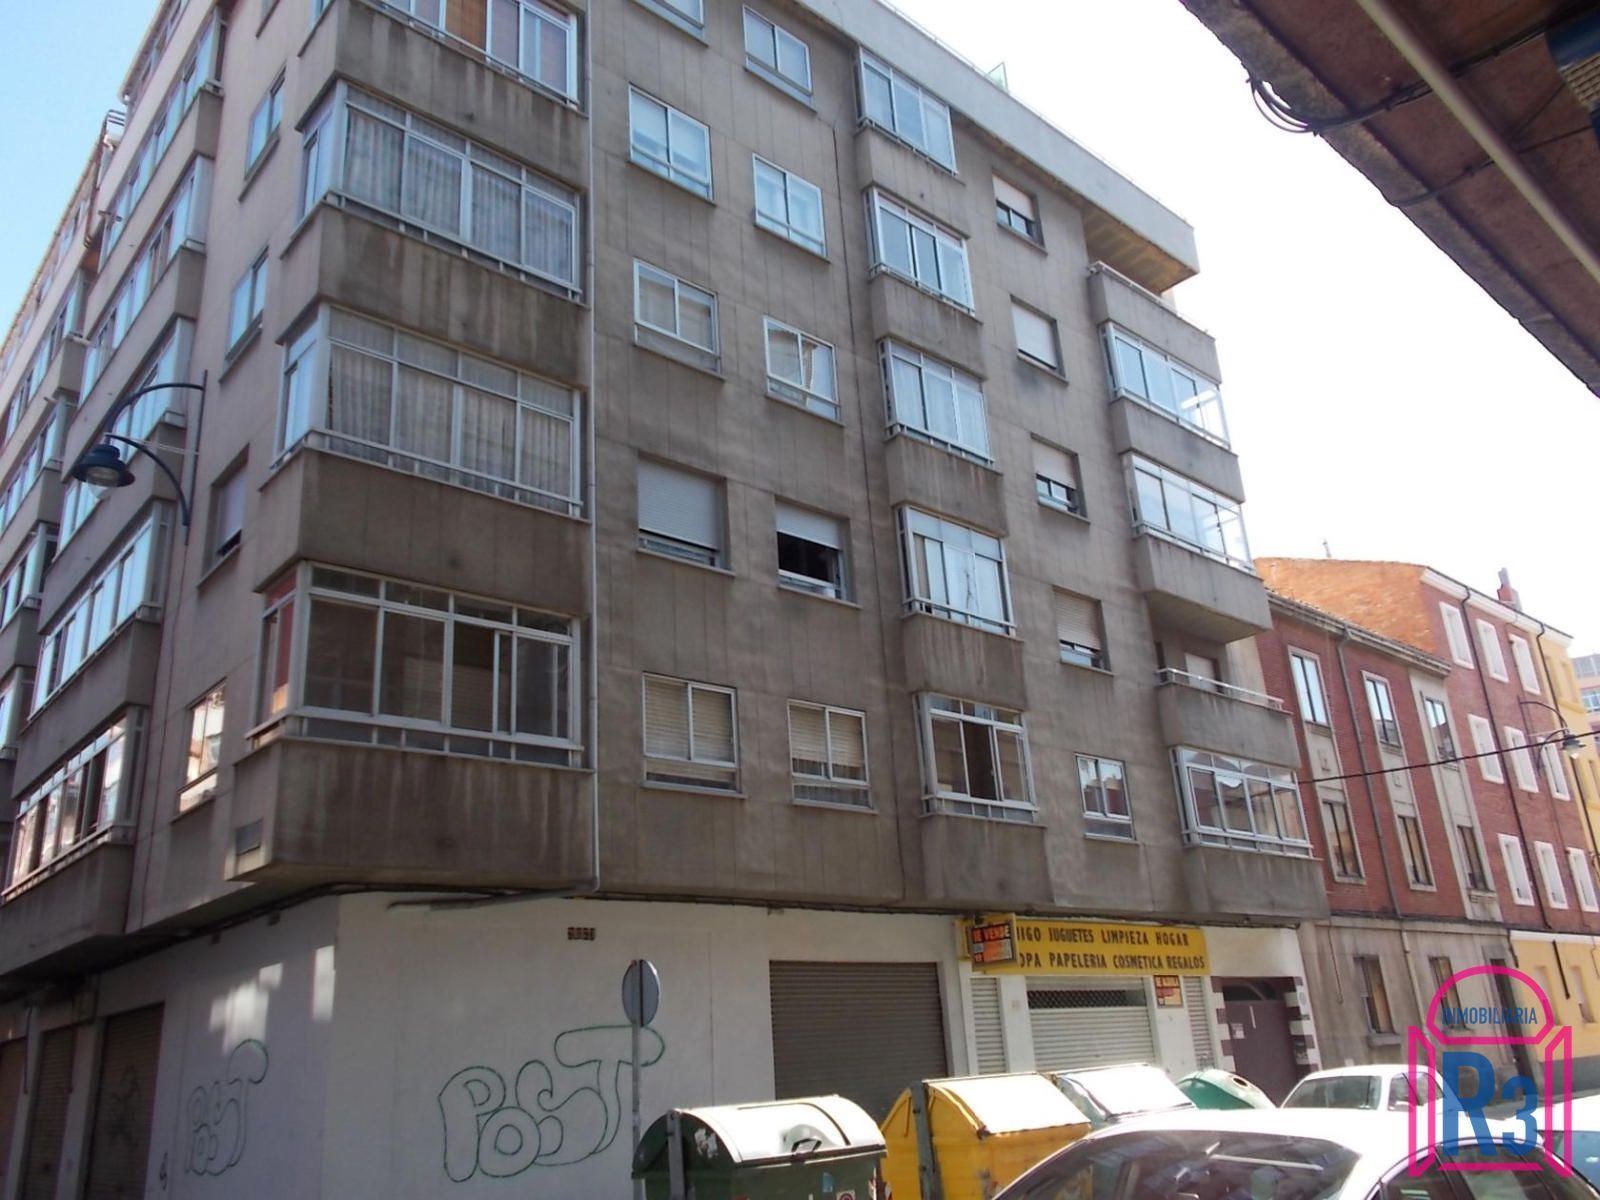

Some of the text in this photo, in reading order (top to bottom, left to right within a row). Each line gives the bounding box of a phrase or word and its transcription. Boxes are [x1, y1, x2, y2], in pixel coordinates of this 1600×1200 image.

[1048, 927, 1094, 943] JUGUETES
[1101, 929, 1149, 945] LIMPIEZA
[1155, 931, 1189, 946] HOGAR
[1049, 952, 1107, 969] PAPELERIA
[1113, 954, 1164, 970] COSMETICA
[1166, 955, 1206, 970] REGALOS
